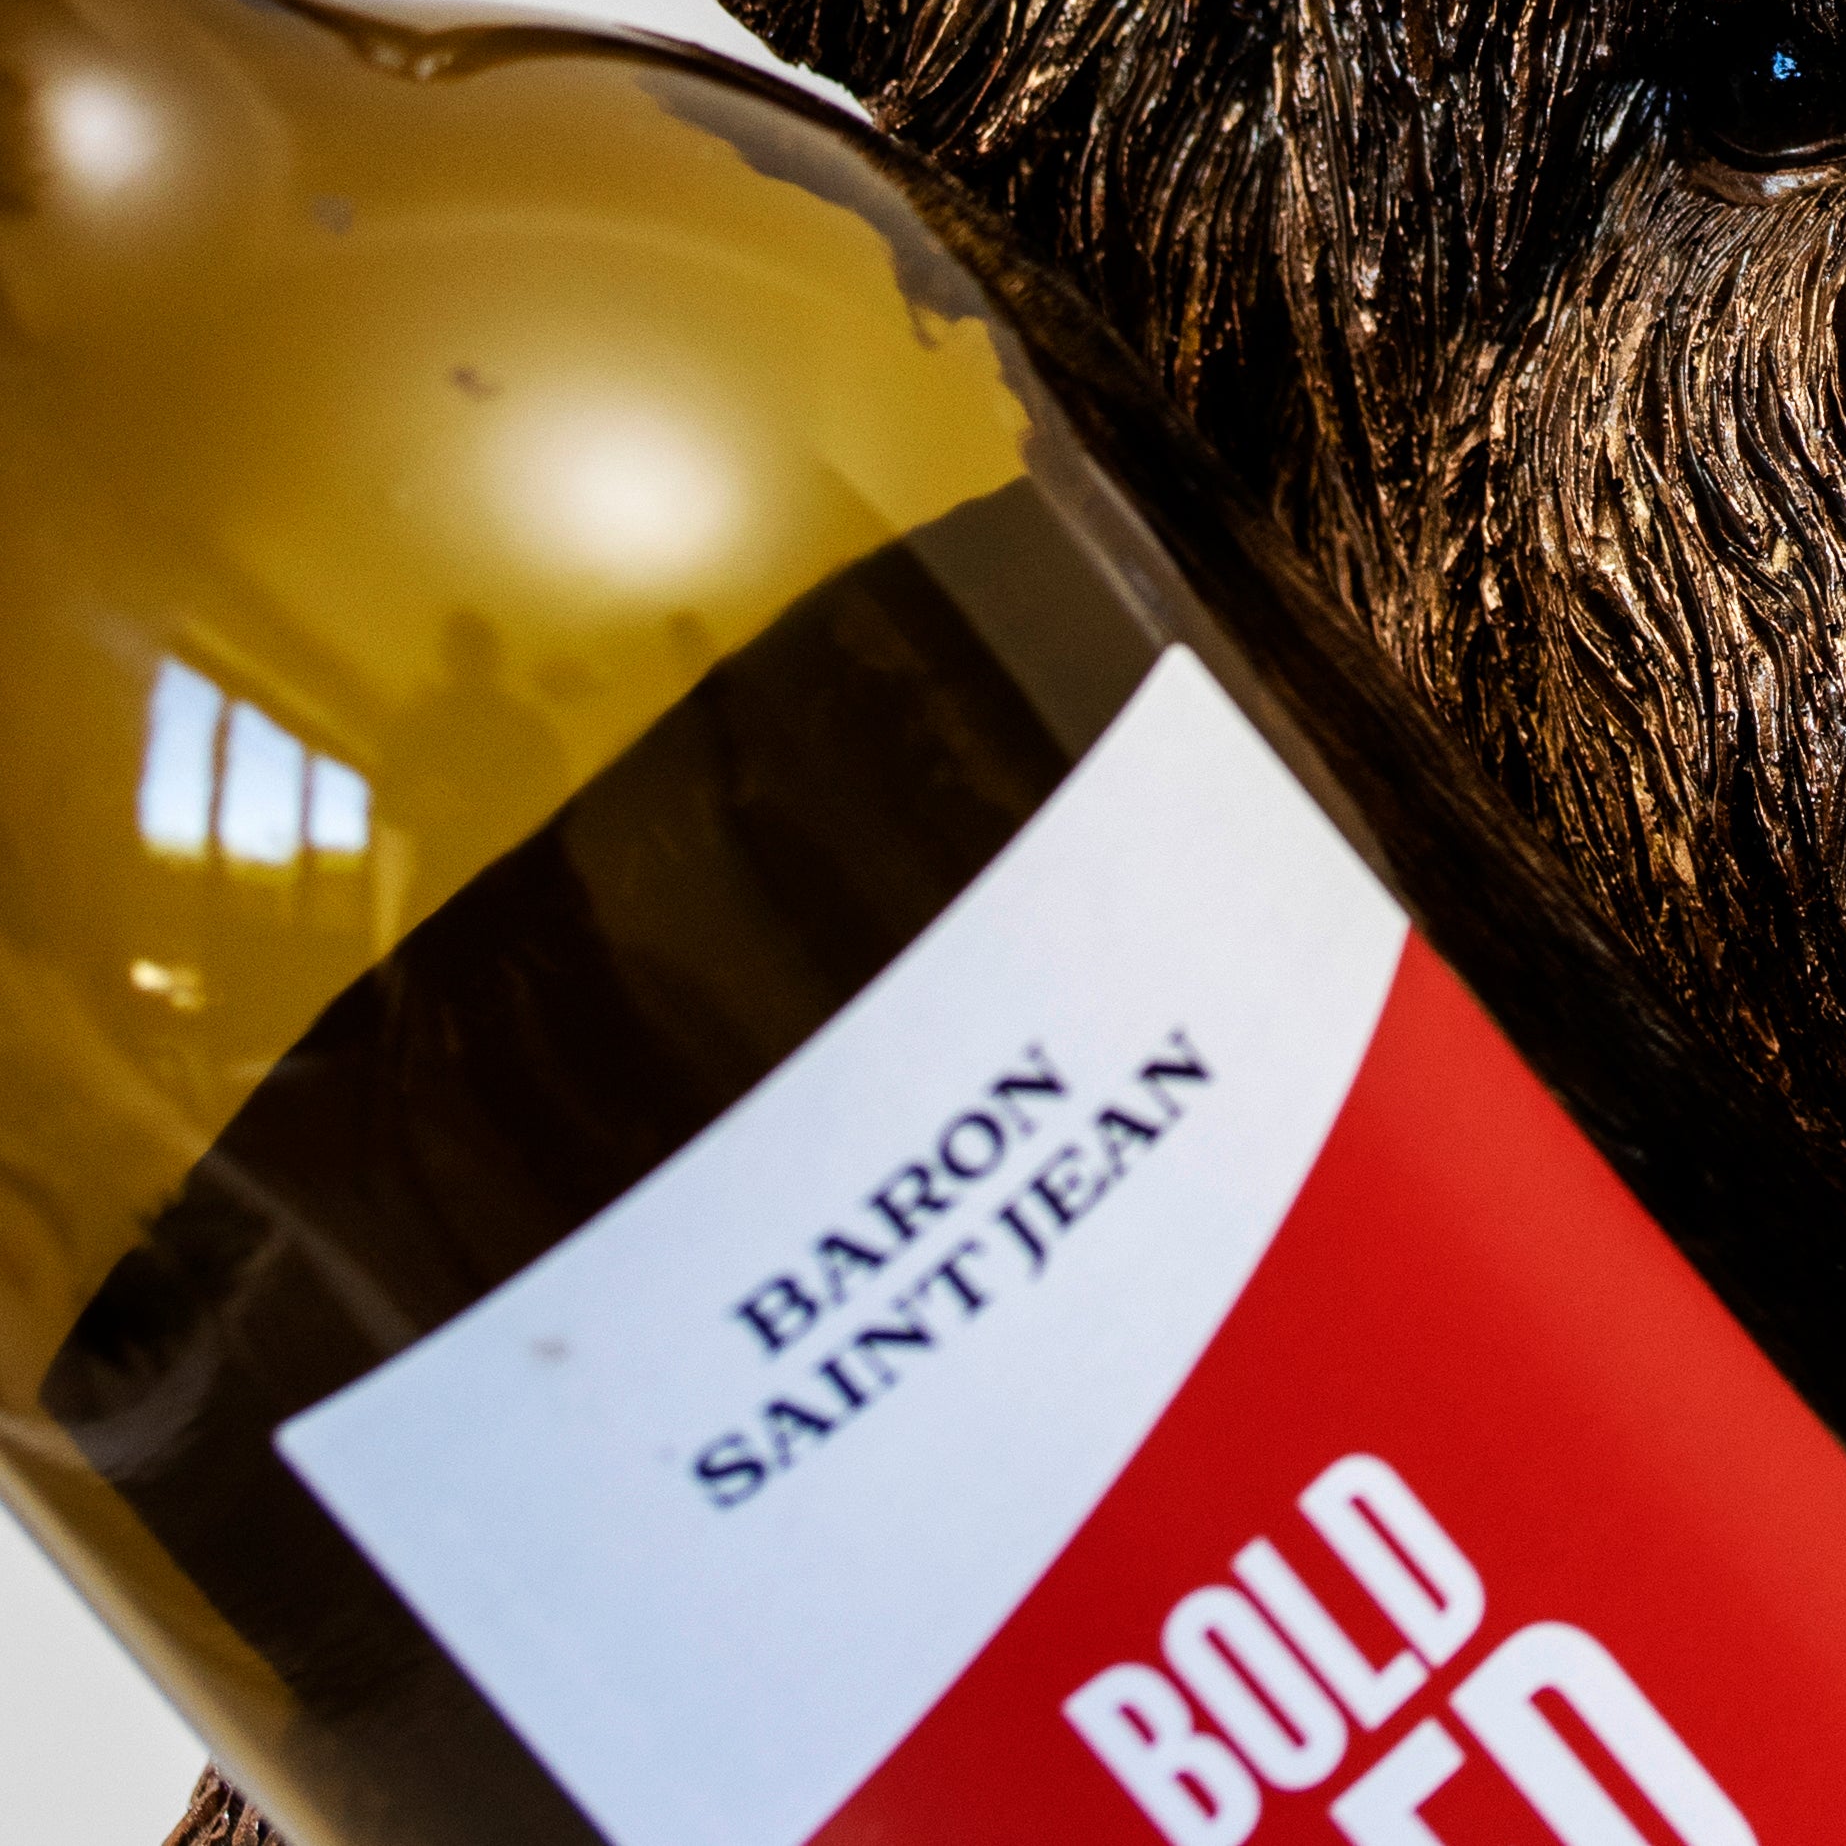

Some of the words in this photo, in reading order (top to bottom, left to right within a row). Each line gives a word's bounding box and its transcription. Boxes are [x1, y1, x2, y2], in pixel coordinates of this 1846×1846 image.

[691, 1236, 989, 1508] SAINT
[995, 1024, 1212, 1280] JEAN
[734, 1038, 1068, 1355] BARON
[1062, 1452, 1487, 1846] BOLD
